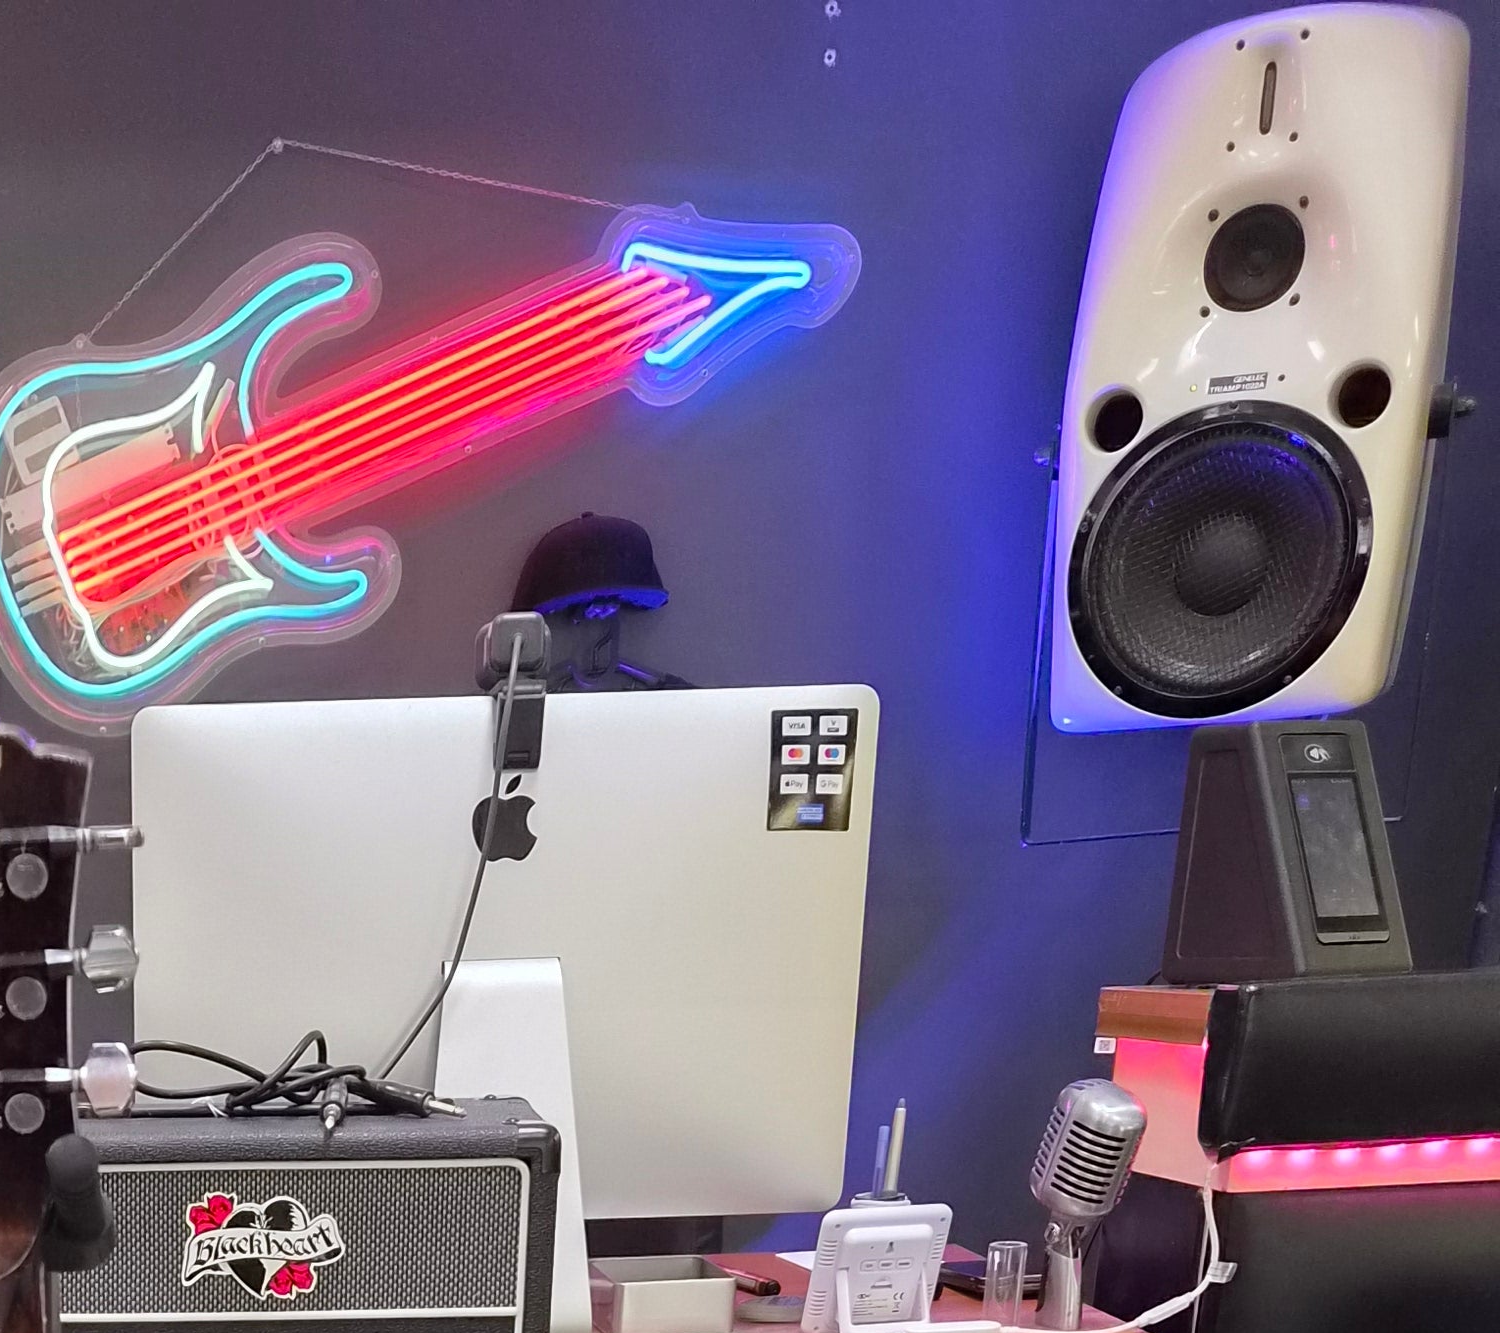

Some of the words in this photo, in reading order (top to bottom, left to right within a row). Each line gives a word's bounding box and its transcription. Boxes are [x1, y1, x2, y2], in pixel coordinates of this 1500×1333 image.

[1233, 373, 1266, 383] GENELEC
[1210, 384, 1241, 393] TRIAMP
[788, 722, 805, 730] VISA
[790, 780, 804, 789] Pay
[194, 1223, 334, 1266] Blackheart
